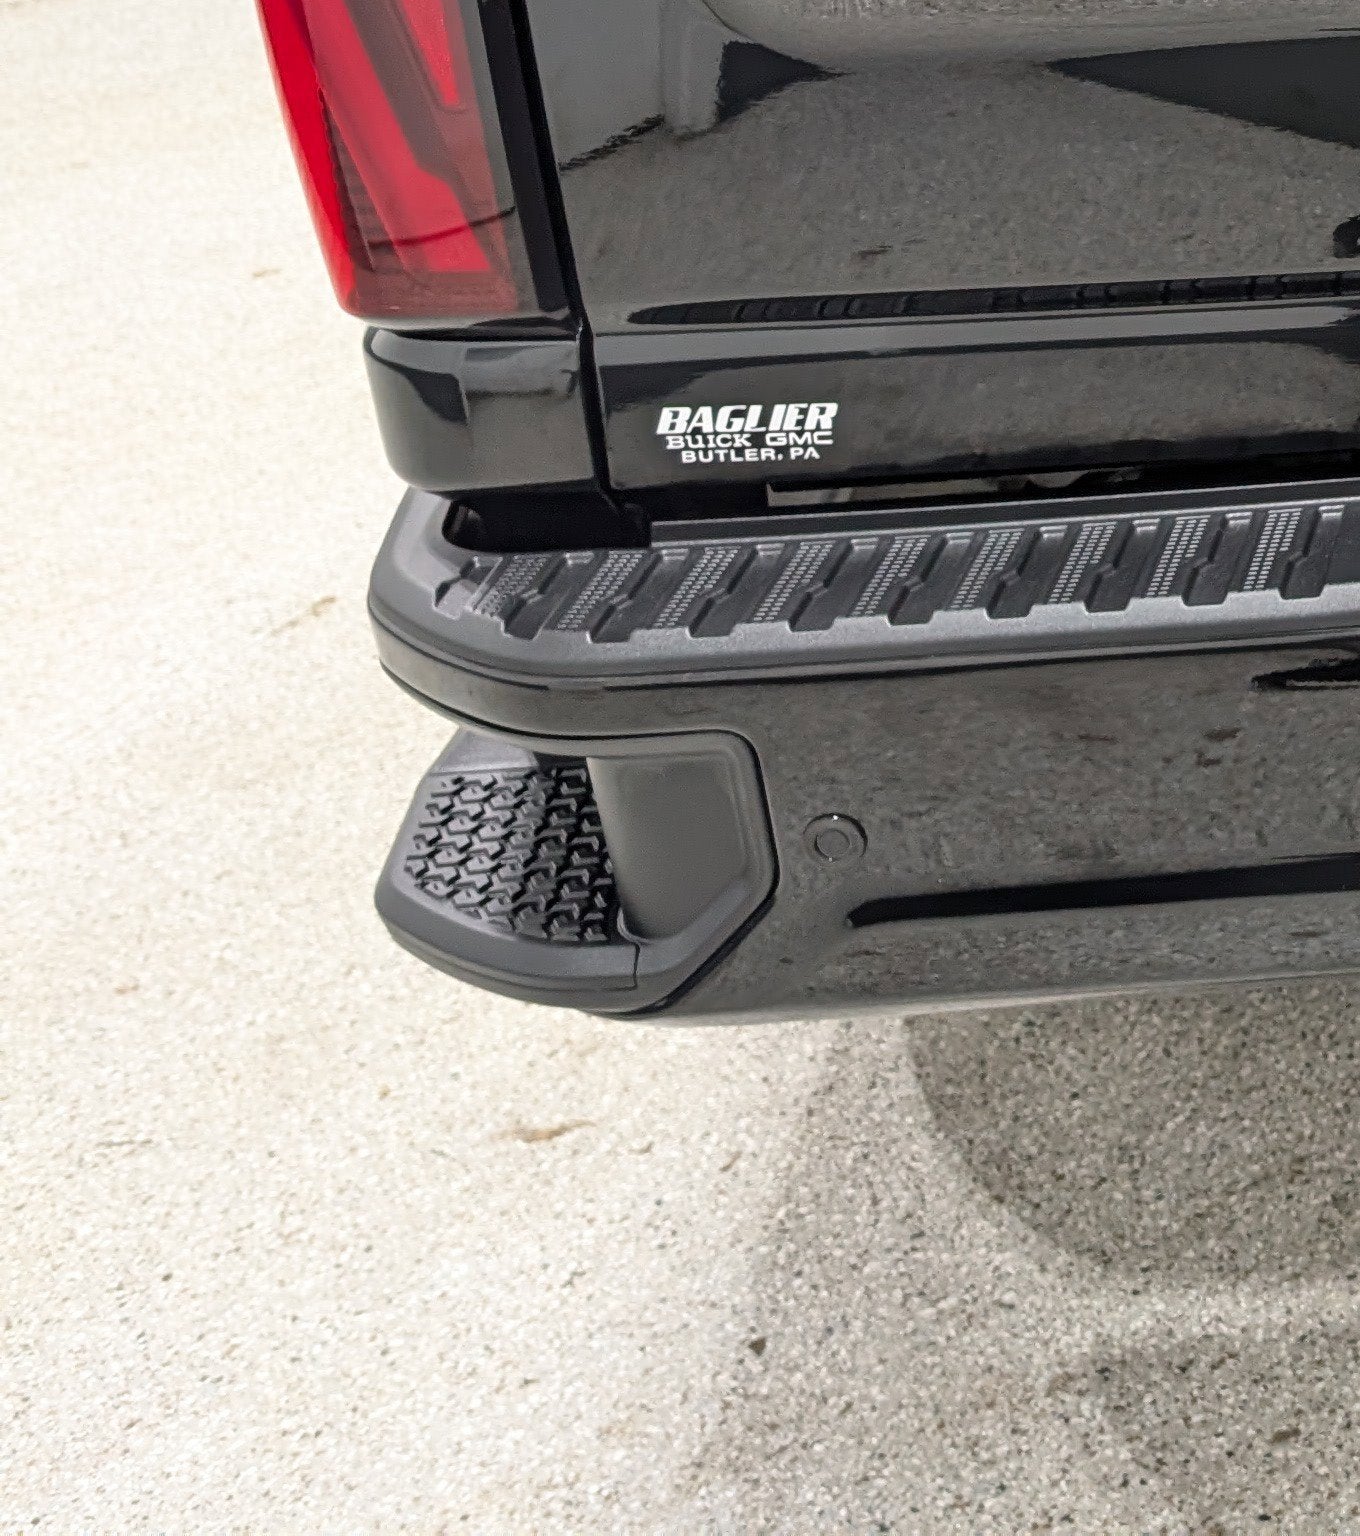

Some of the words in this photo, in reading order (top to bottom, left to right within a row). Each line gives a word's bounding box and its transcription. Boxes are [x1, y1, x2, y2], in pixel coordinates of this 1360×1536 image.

[656, 402, 839, 435] BAGLIER
[666, 433, 752, 450] BUICK
[765, 431, 833, 446] GMC
[681, 448, 783, 464] BUTLER,
[790, 446, 820, 461] PA
